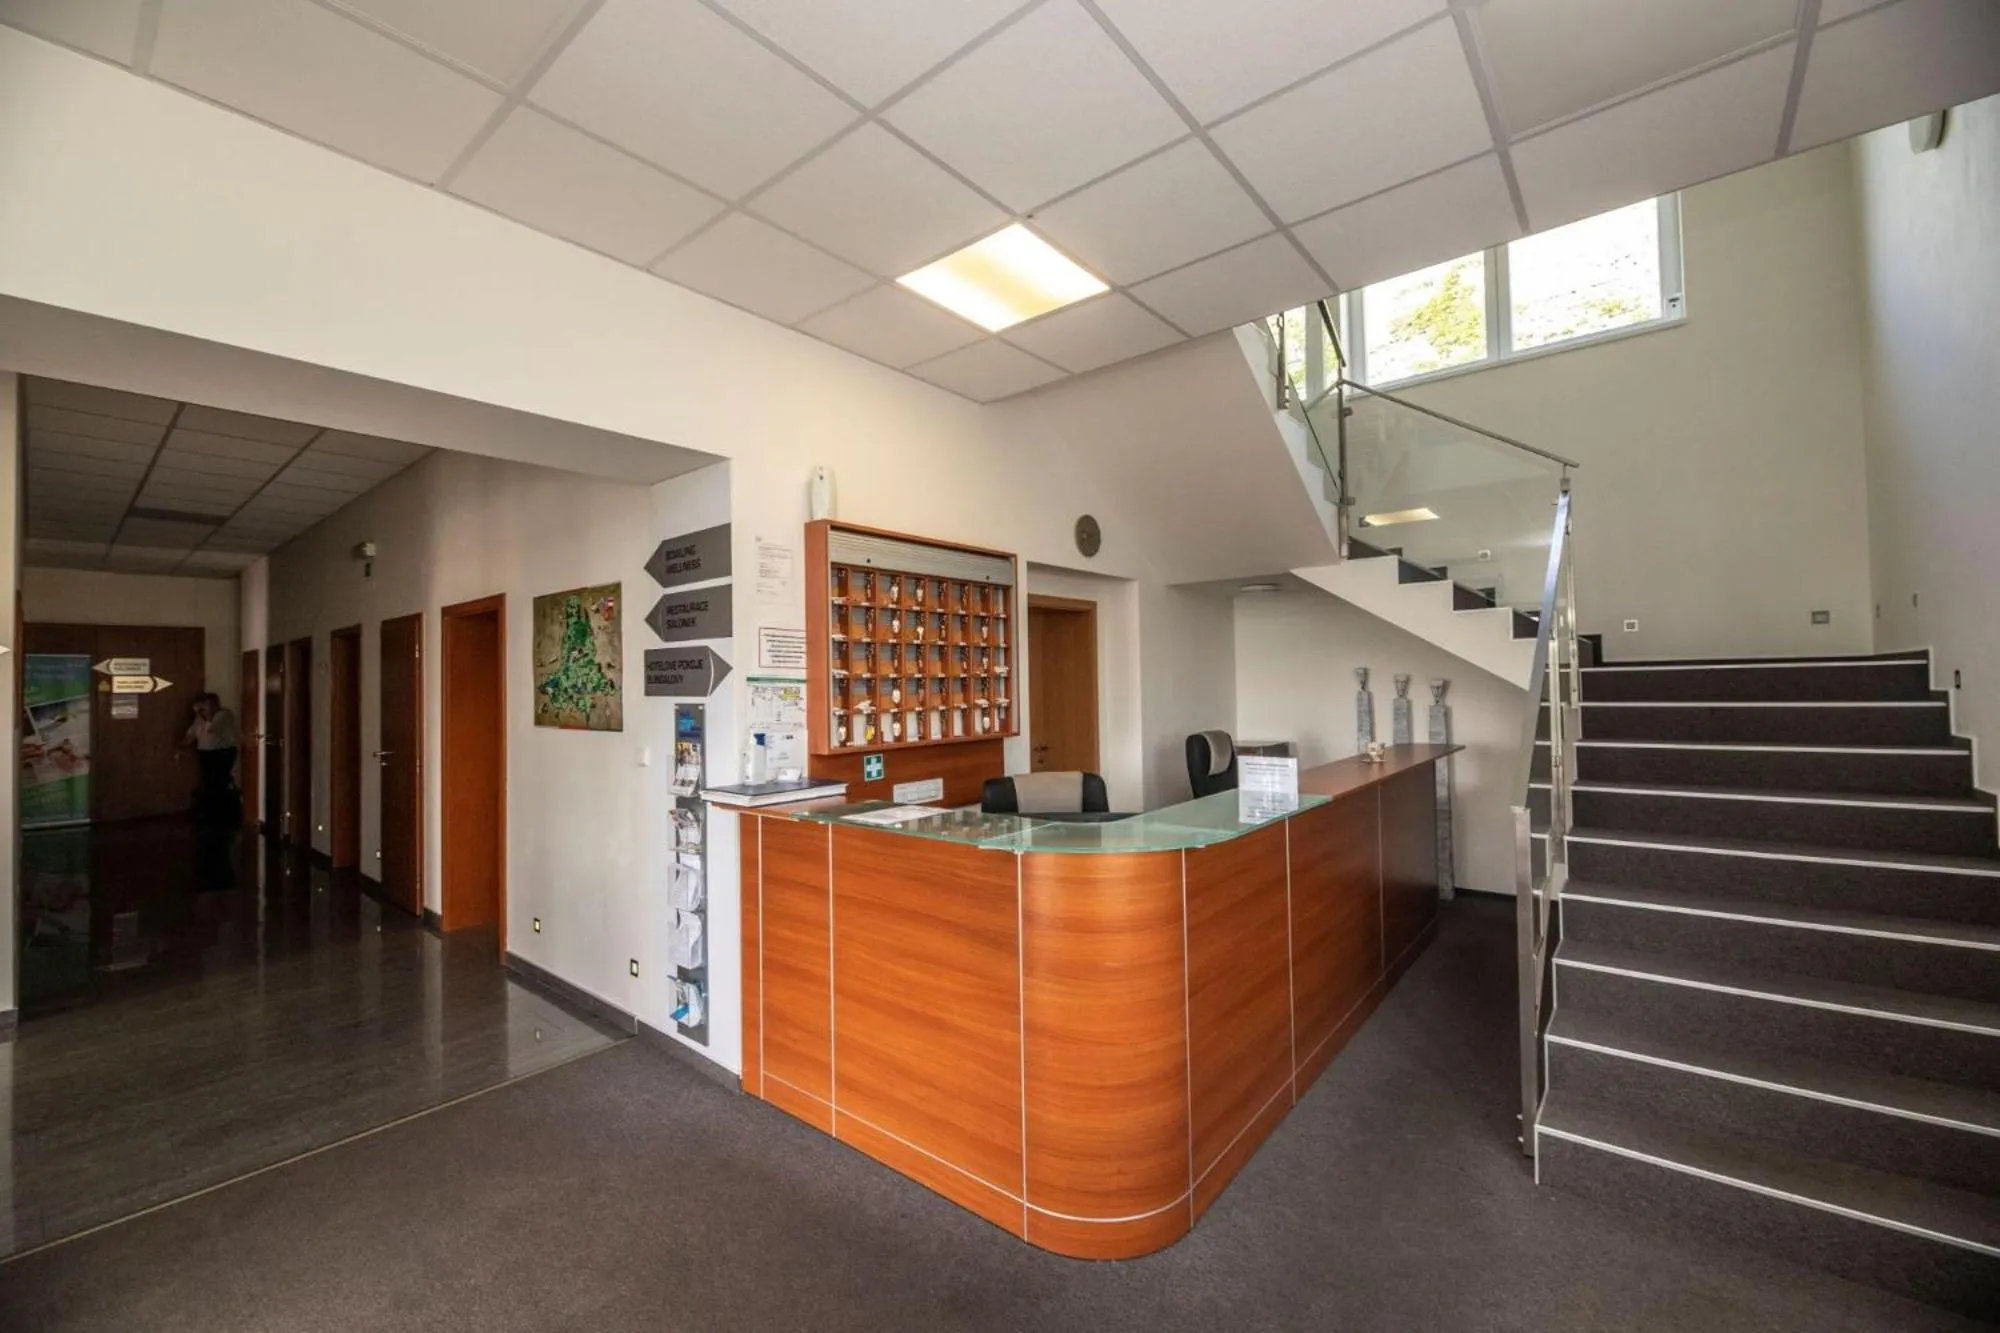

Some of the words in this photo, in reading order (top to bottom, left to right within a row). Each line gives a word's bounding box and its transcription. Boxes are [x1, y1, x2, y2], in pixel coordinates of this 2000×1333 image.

[666, 544, 696, 561] BOWLING
[666, 558, 701, 574] WELLNESS
[666, 600, 709, 615] RESTAURACE
